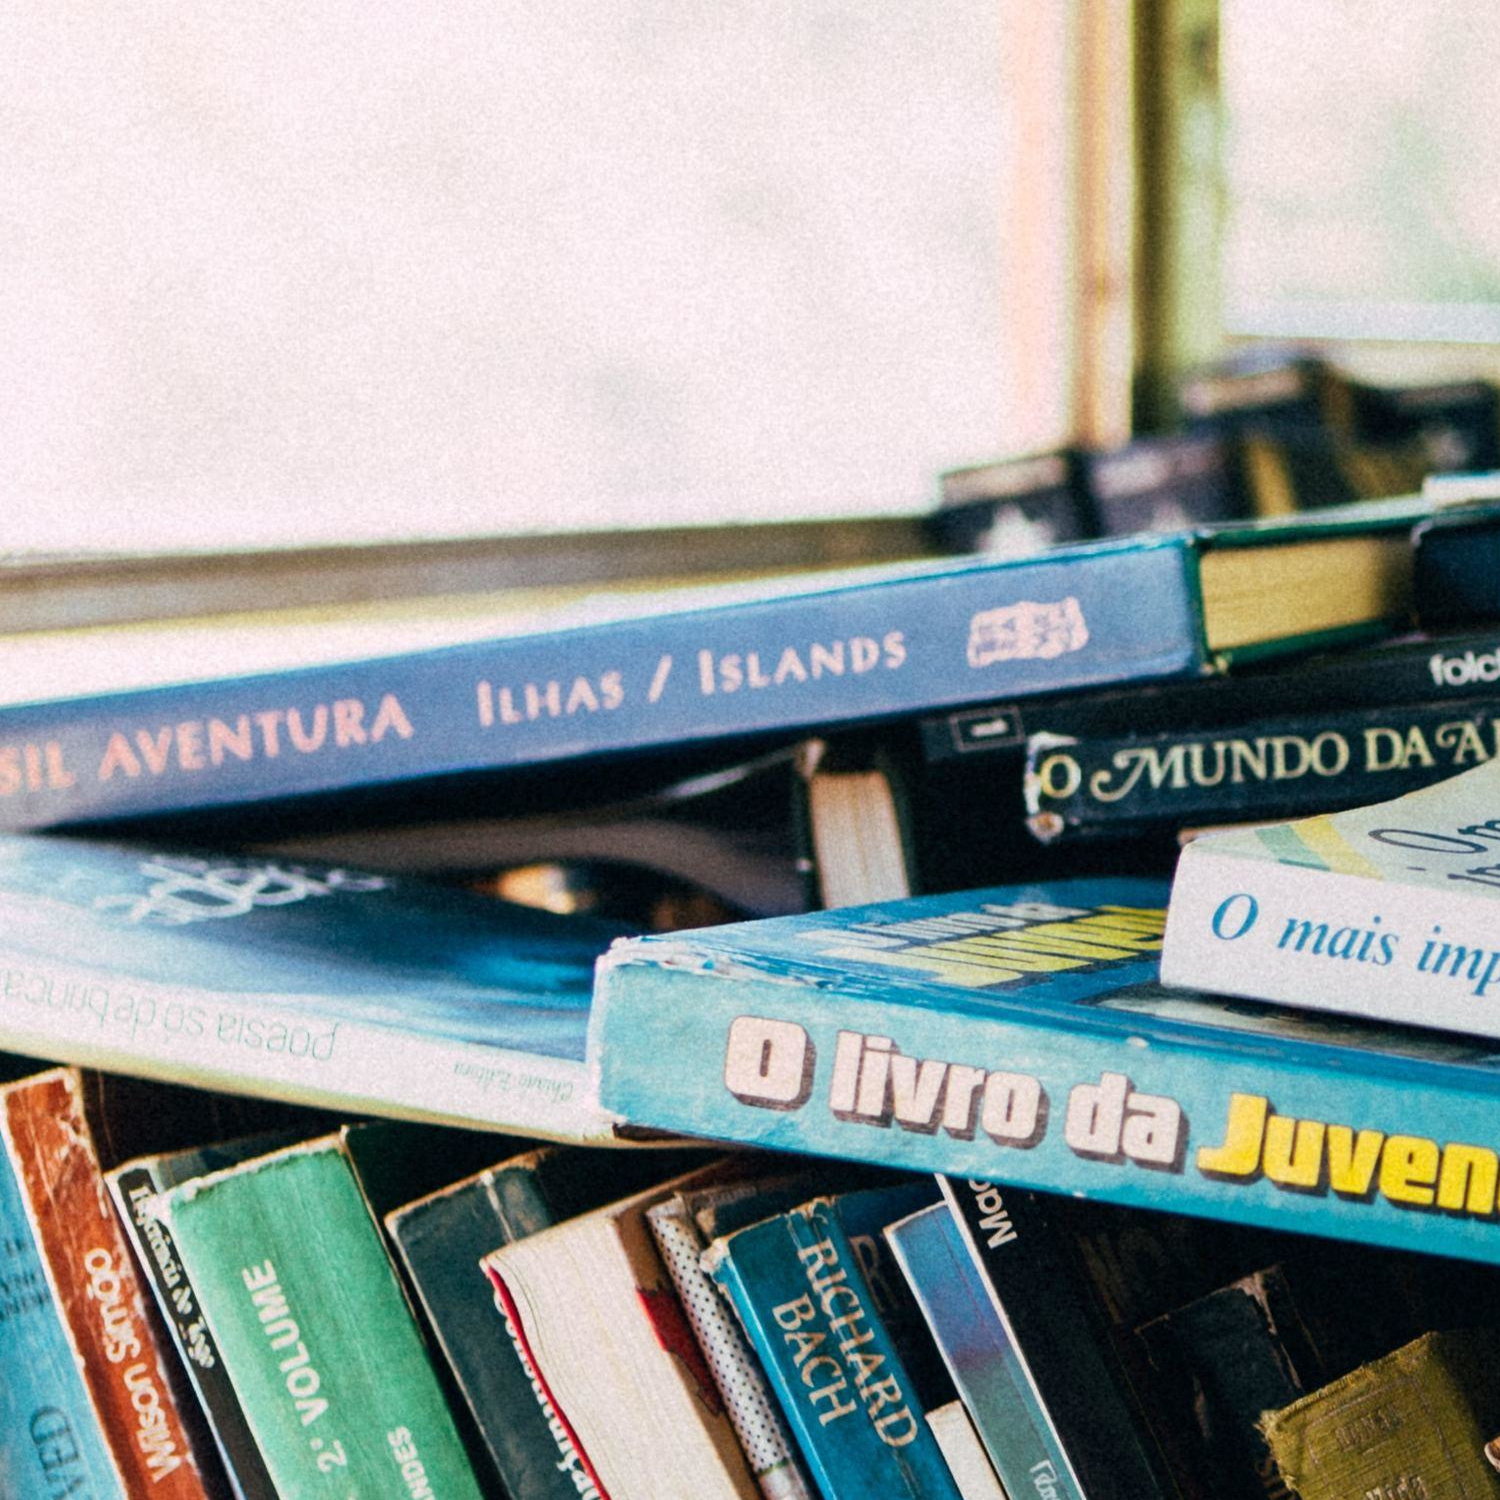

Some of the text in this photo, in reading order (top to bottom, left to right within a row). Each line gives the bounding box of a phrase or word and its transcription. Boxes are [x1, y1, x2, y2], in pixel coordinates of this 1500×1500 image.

[99, 694, 414, 779] AVENTURA
[477, 670, 624, 728] ILHAS
[699, 631, 907, 695] ISLANDS
[1039, 754, 1081, 800] O
[1091, 730, 1349, 804] MUNDO
[1364, 726, 1434, 772] DA
[1367, 828, 1488, 854] O
[1211, 892, 1259, 941] O
[1277, 912, 1399, 967] mais
[724, 1015, 815, 1110] O
[829, 1029, 1049, 1149] livro
[1064, 1071, 1189, 1172] da
[83, 1248, 181, 1482] Wilson Simão
[241, 1259, 328, 1427] VOLUME
[773, 1293, 857, 1426] BACH
[798, 1239, 918, 1447] RICHARD
